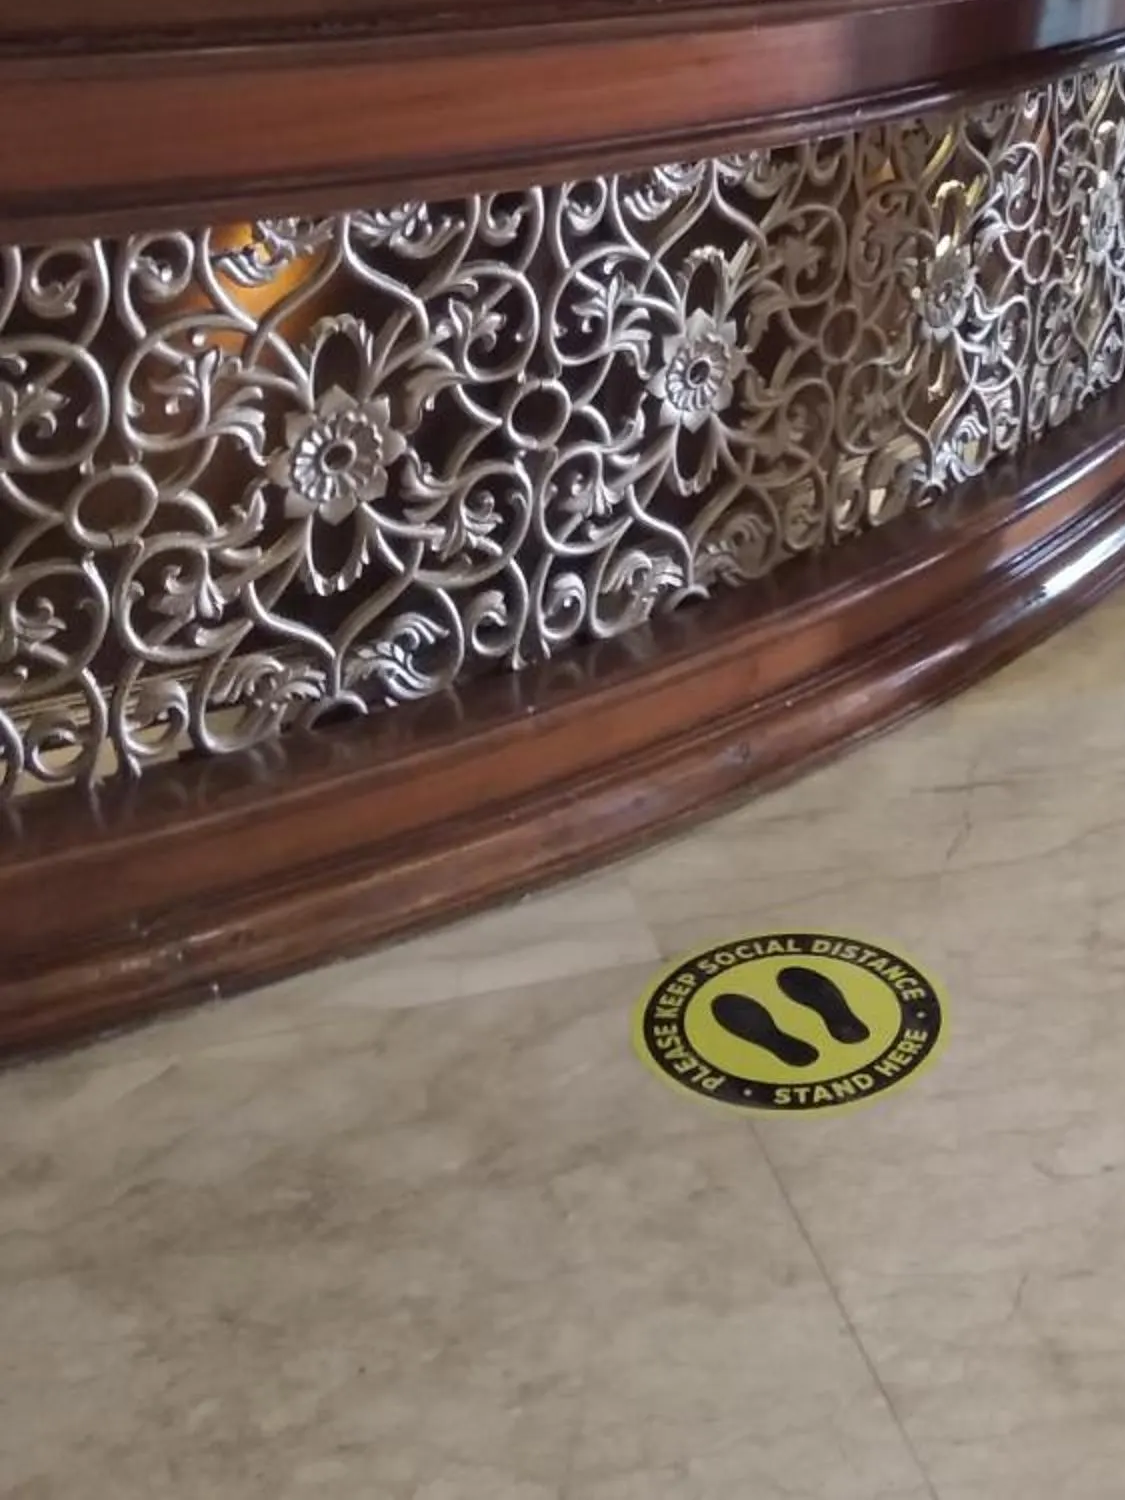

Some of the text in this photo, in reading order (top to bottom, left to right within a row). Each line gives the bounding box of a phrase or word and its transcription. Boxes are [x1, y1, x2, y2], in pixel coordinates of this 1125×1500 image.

[654, 938, 927, 1091] PLEASE KEEP SOCIAL DISTANCE
[773, 1028, 929, 1105] STAND HERE
